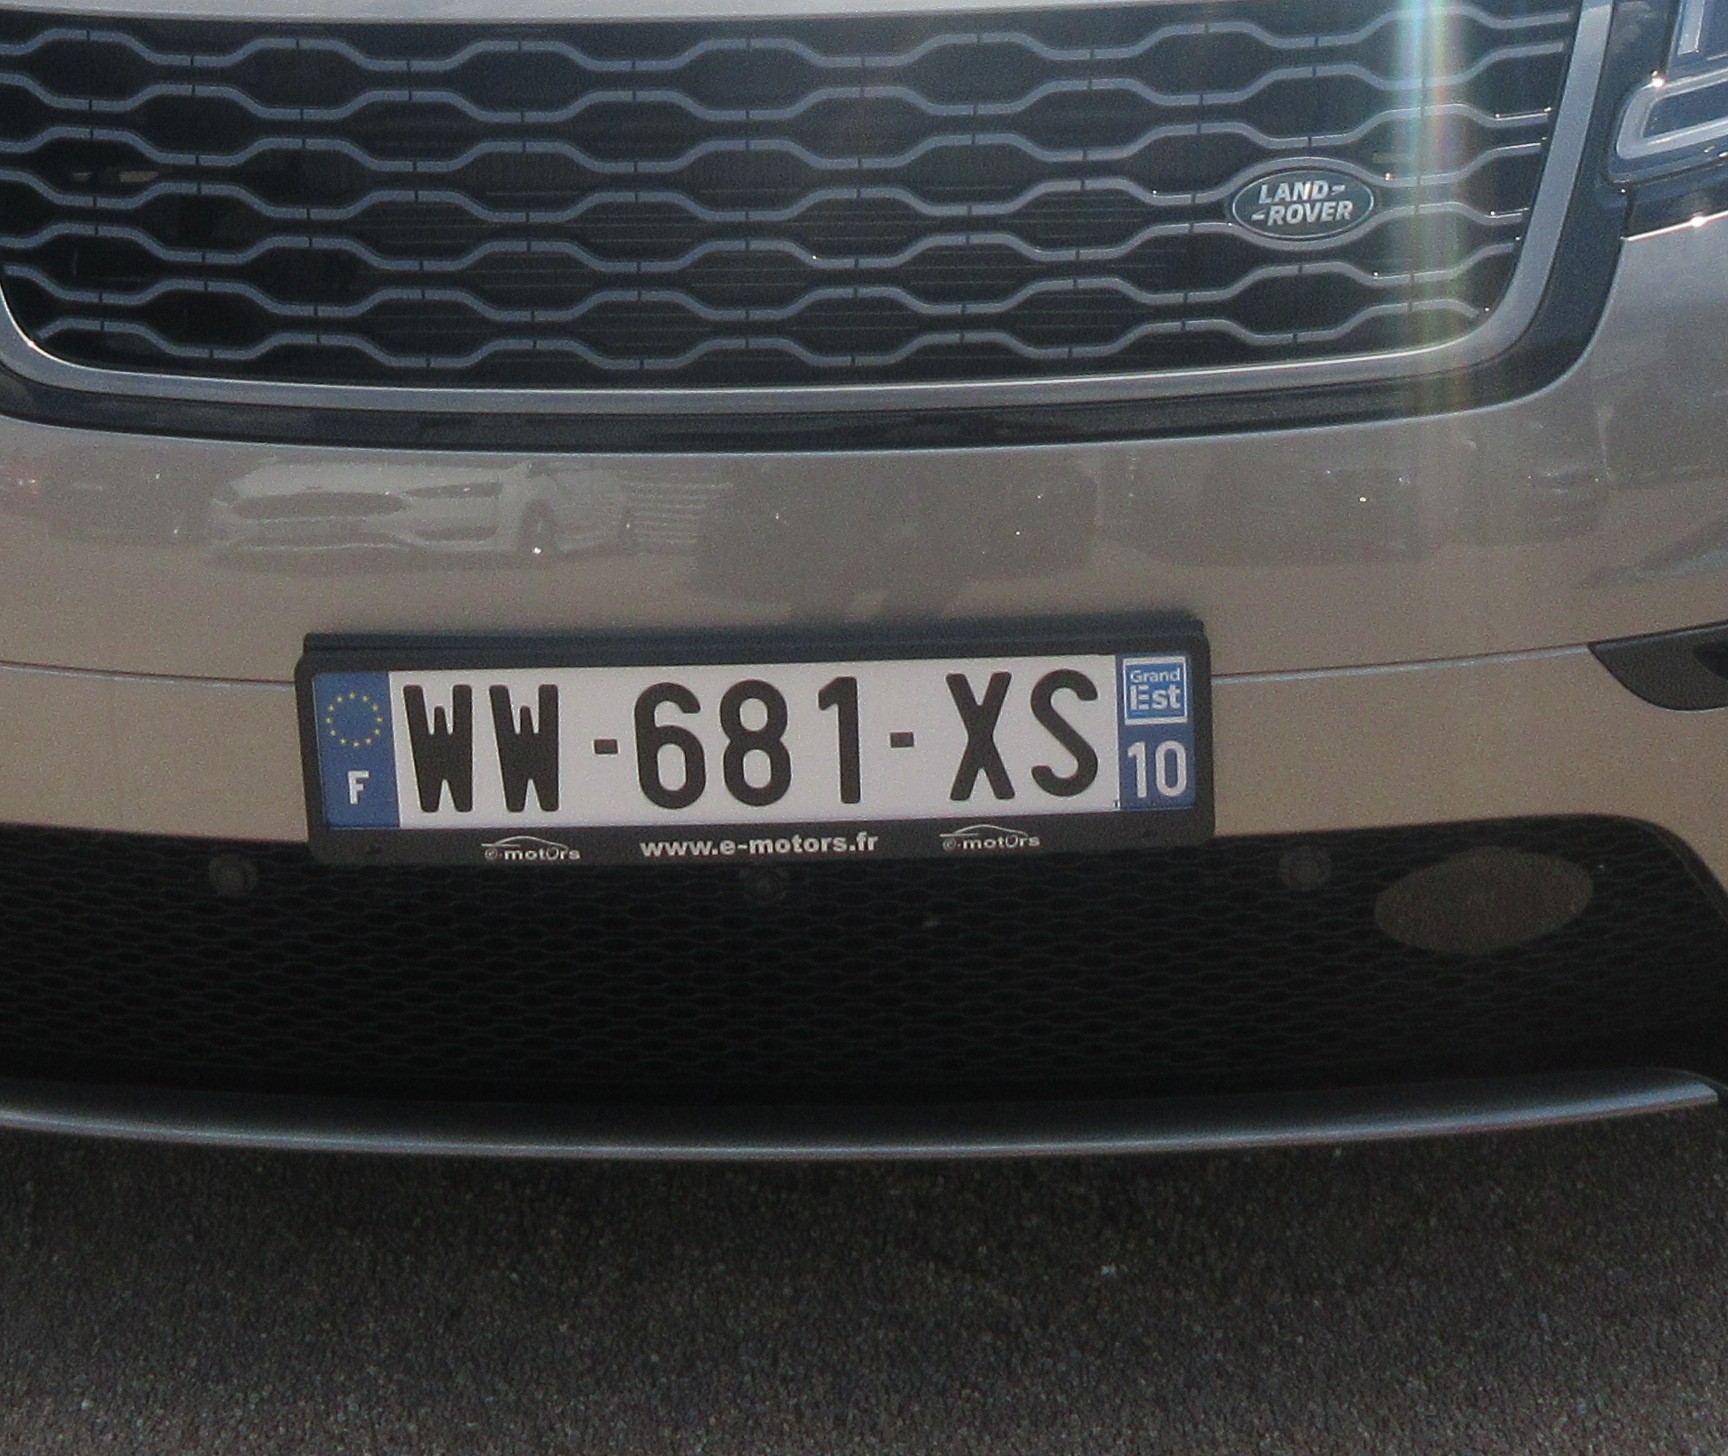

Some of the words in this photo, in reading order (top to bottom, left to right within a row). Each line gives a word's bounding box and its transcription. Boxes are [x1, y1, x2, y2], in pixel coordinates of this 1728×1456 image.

[1129, 667, 1182, 684] Grand
[1129, 684, 1182, 712] Est
[402, 668, 1099, 814] WW-681-XS
[1127, 740, 1188, 799] 10
[347, 770, 370, 805] F
[640, 831, 879, 857] www.e-motors.fr
